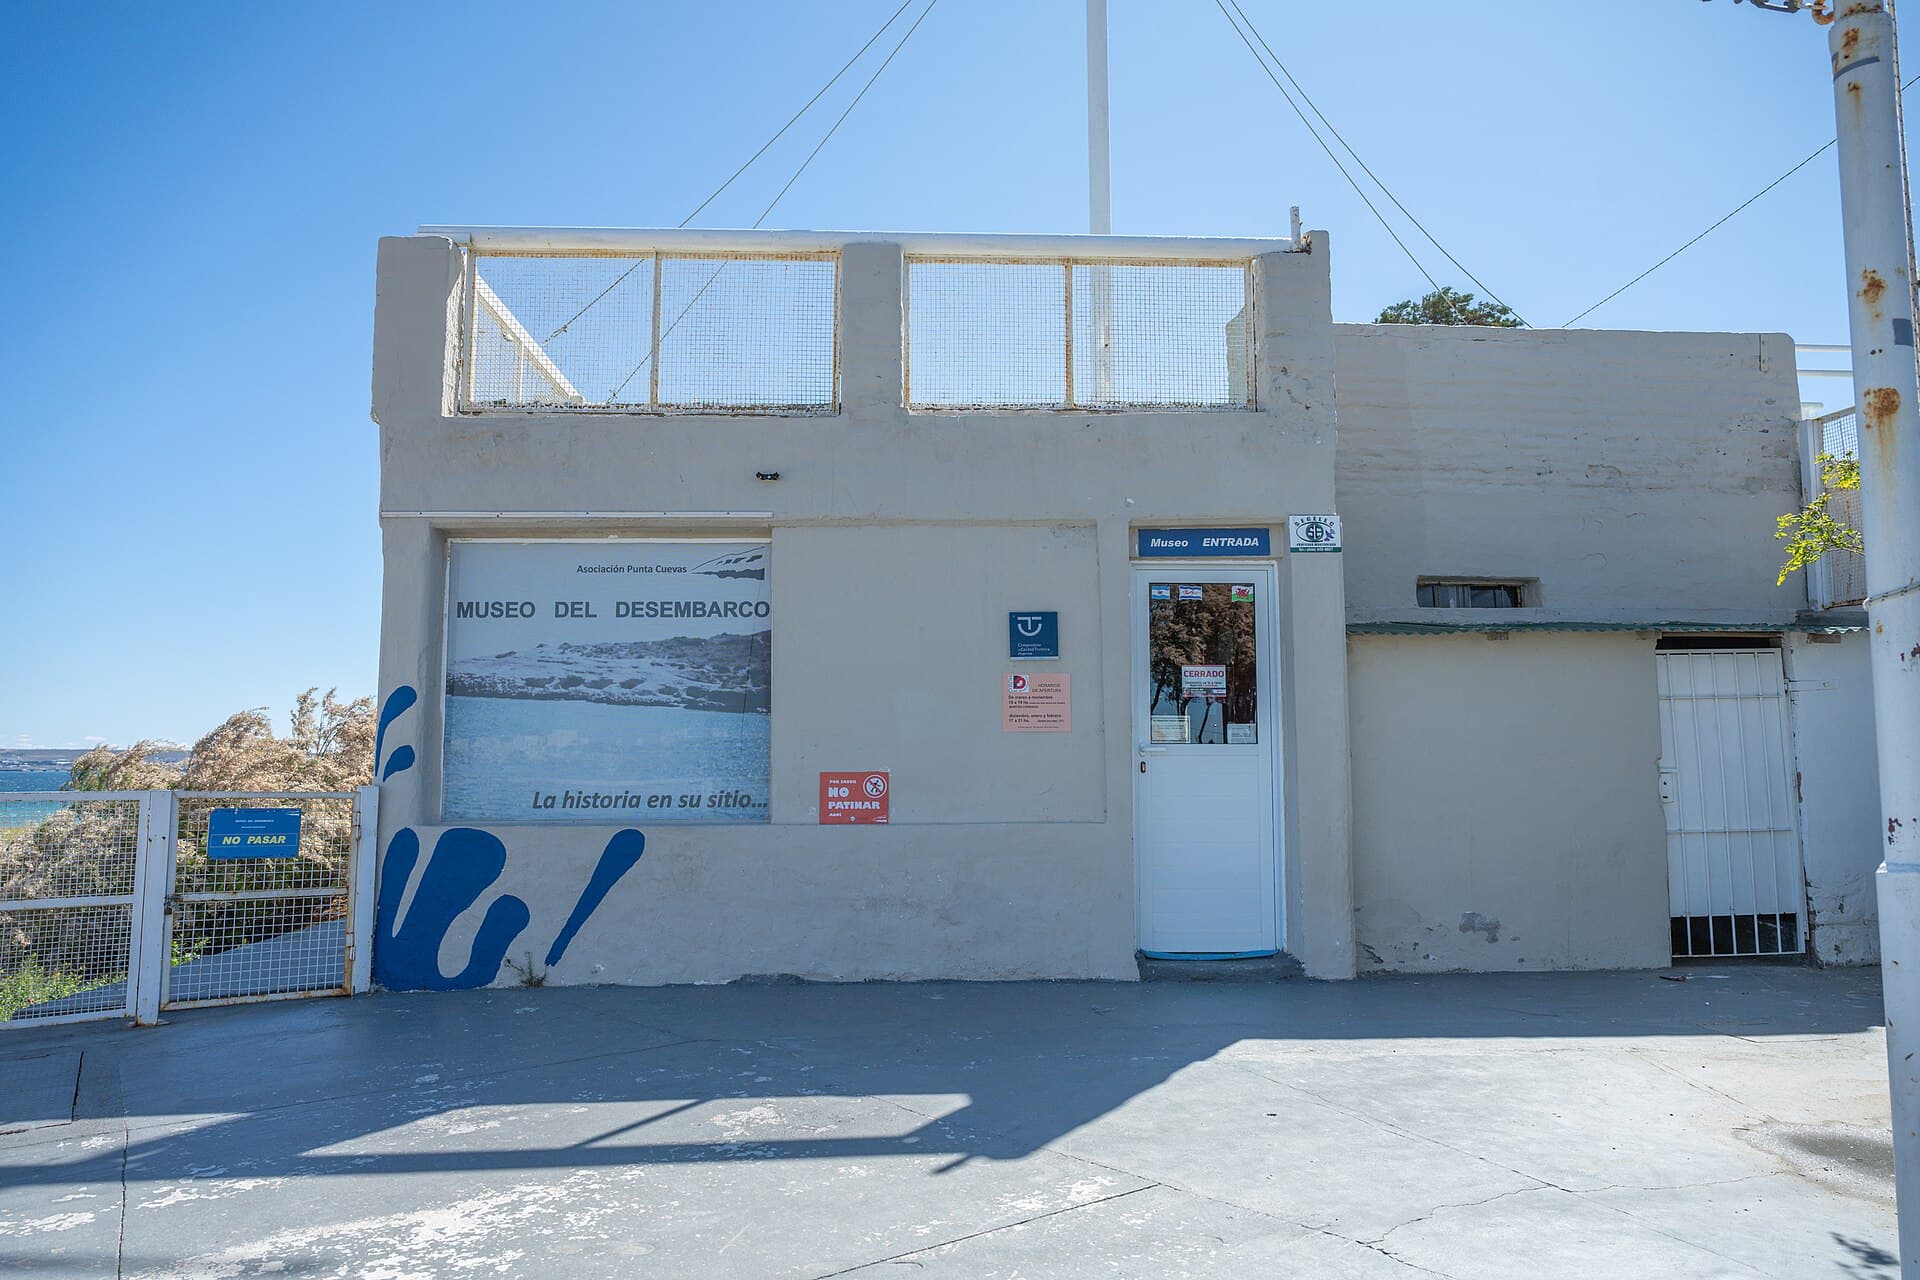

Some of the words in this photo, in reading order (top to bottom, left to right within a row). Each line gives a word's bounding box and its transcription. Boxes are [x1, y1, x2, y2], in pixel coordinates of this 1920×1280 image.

[1150, 538, 1189, 548] Museo
[1202, 537, 1260, 548] ENTRADA
[576, 564, 625, 574] Asociación
[627, 565, 653, 574] Punta
[655, 565, 687, 574] Cuevas
[456, 601, 536, 618] MUSEO
[554, 601, 597, 618] DEL
[615, 601, 771, 618] DESEMBARCO
[1183, 670, 1225, 678] CERRADO
[828, 787, 849, 798] NO
[532, 791, 557, 809] La
[562, 790, 641, 809] historia
[647, 793, 672, 809] en
[677, 793, 701, 808] su
[707, 790, 768, 809] sitio...
[828, 801, 881, 810] PATINAR
[222, 836, 241, 845] NO
[247, 836, 287, 844] PASAR
